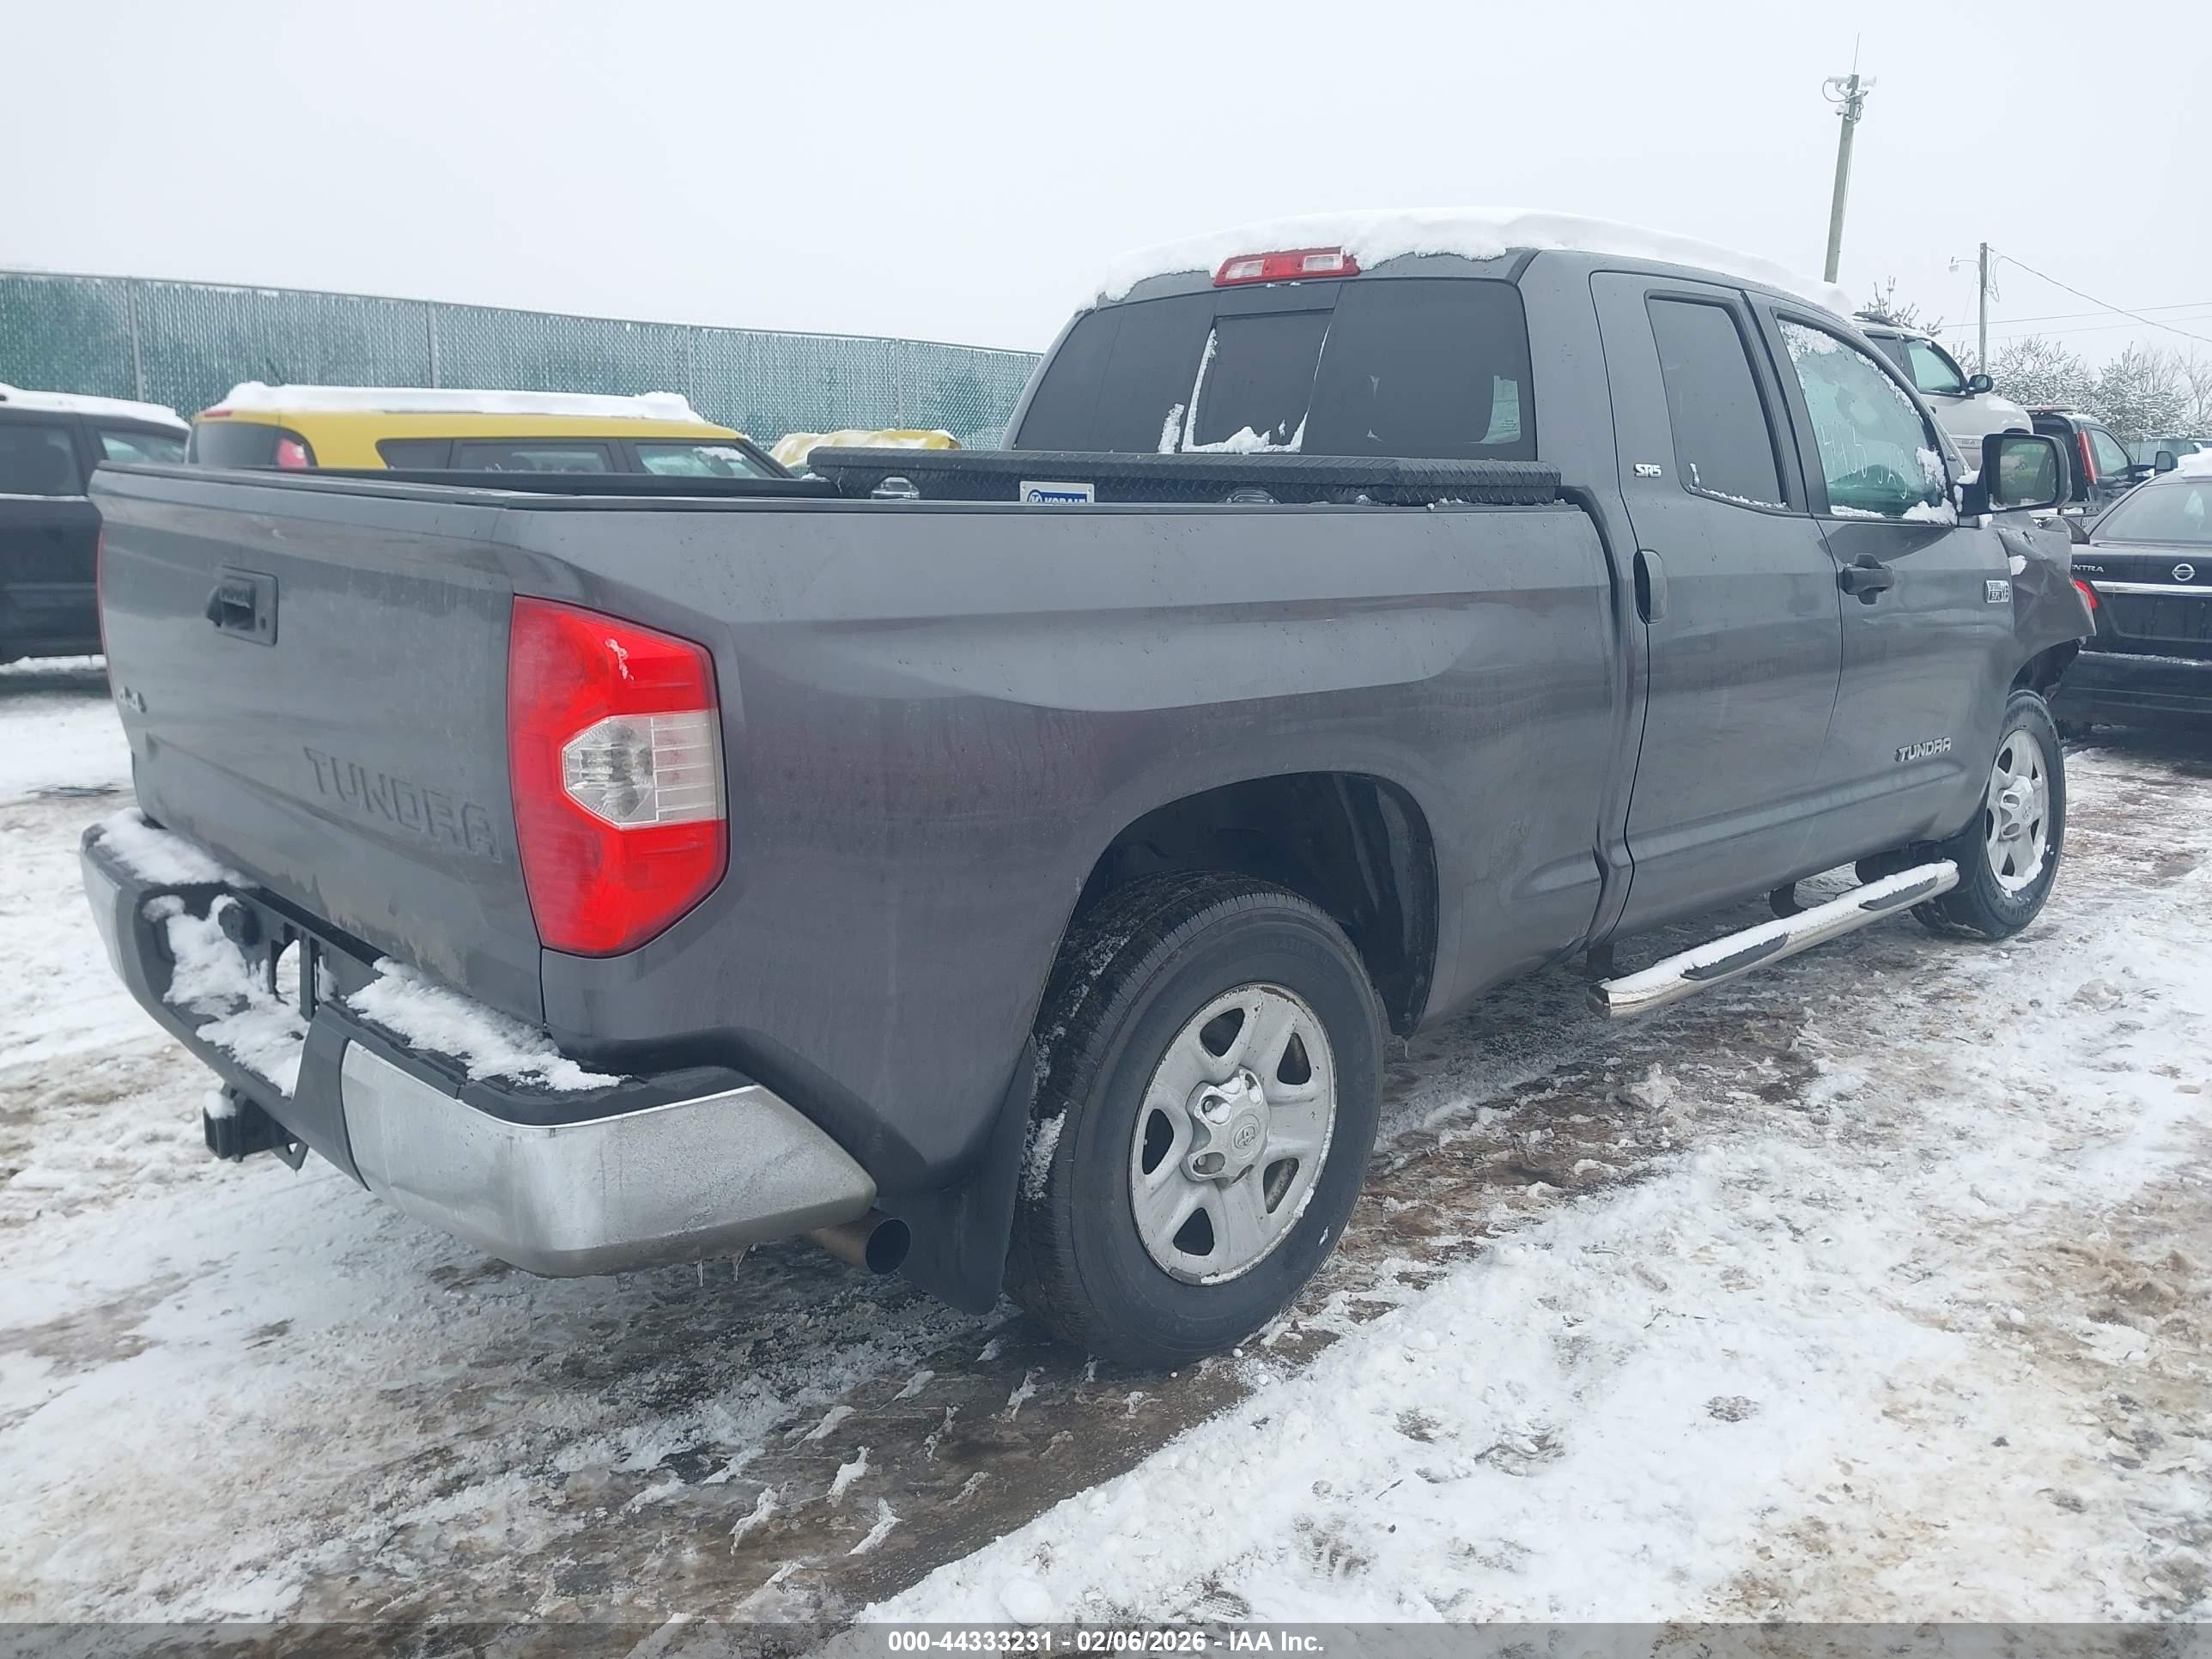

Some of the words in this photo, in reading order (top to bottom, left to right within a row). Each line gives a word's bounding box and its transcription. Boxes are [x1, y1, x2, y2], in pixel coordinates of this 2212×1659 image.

[1634, 463, 1662, 478] SR5
[2071, 564, 2104, 573] NTRA
[1895, 737, 1951, 763] TUNDRA
[303, 746, 501, 863] TUNDRA
